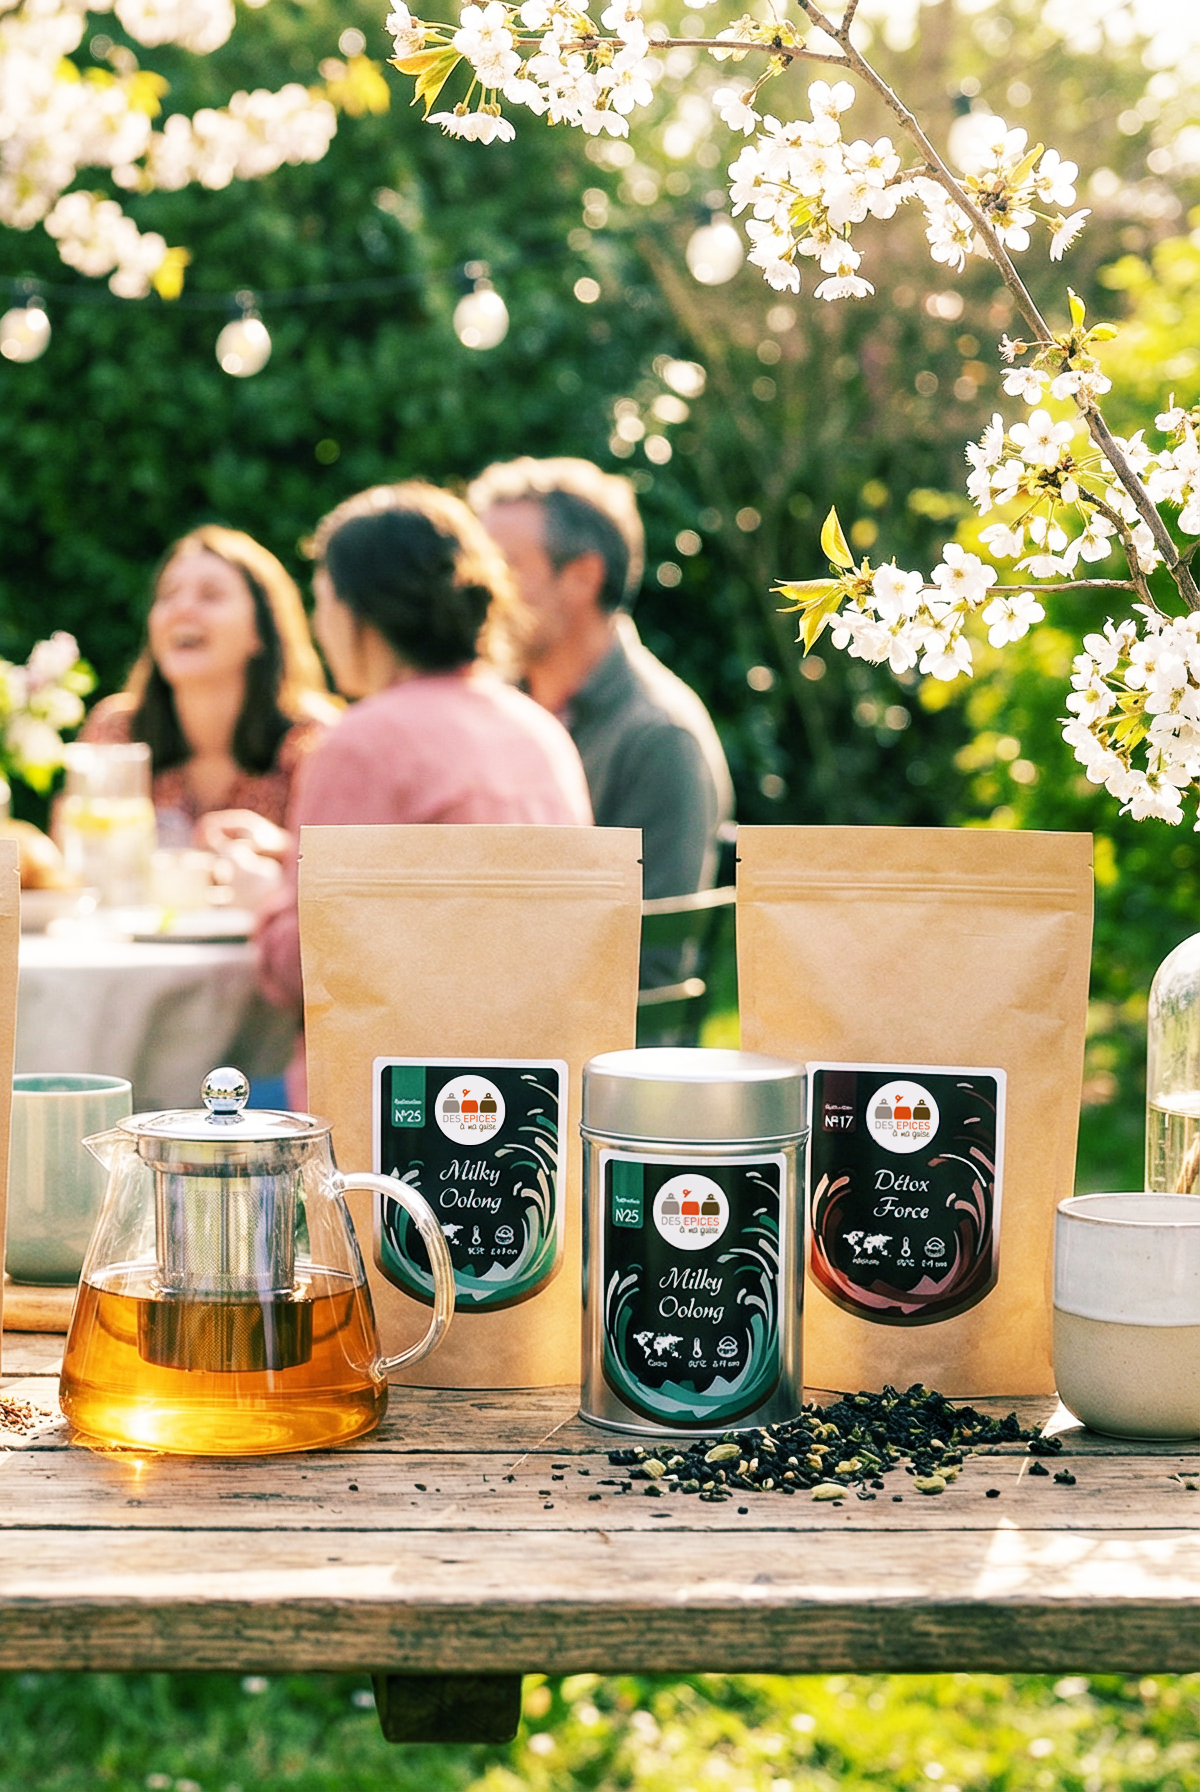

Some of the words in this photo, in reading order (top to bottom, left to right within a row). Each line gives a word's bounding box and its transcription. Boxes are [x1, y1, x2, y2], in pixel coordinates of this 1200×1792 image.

[443, 1115, 461, 1123] DES
[463, 1115, 497, 1123] EPICES
[875, 1121, 894, 1129] DES
[896, 1121, 930, 1130] EPICES
[439, 1159, 500, 1186] Milky
[439, 1187, 502, 1214] Oolong
[873, 1196, 930, 1219] Force
[661, 1216, 681, 1225] DES
[684, 1217, 719, 1226] EPICES
[659, 1267, 723, 1296] Milky
[659, 1295, 725, 1324] Oolong
